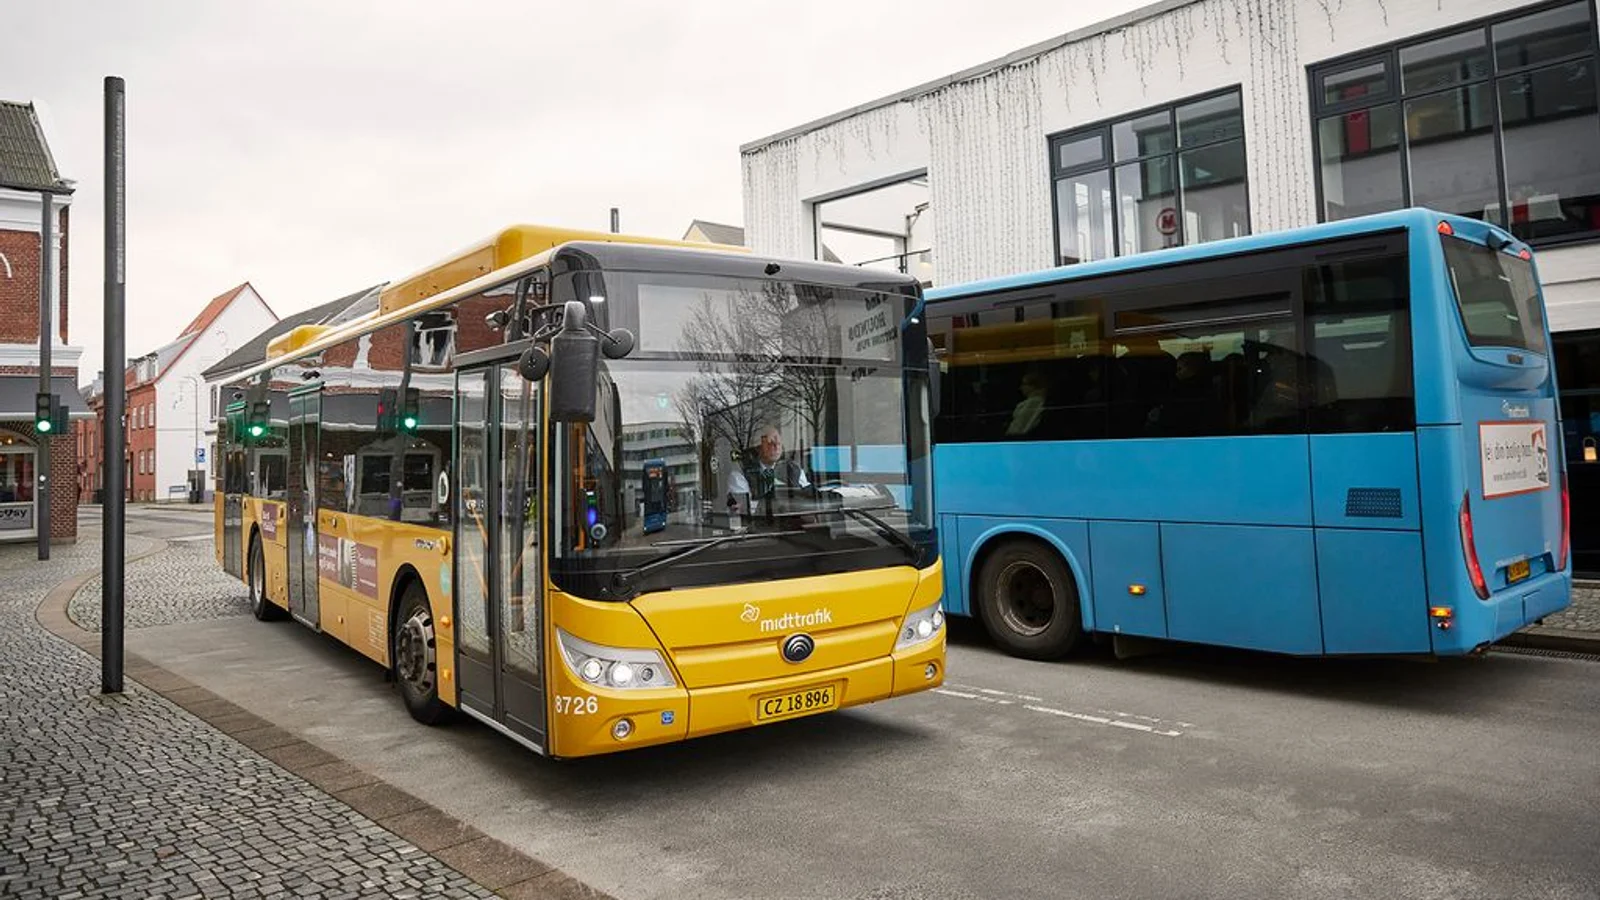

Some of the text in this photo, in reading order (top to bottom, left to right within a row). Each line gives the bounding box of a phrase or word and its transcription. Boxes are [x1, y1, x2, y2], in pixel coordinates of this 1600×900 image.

[760, 607, 833, 632] midttrafik
[556, 695, 598, 715] 8726
[764, 689, 829, 715] CZ 18 896
